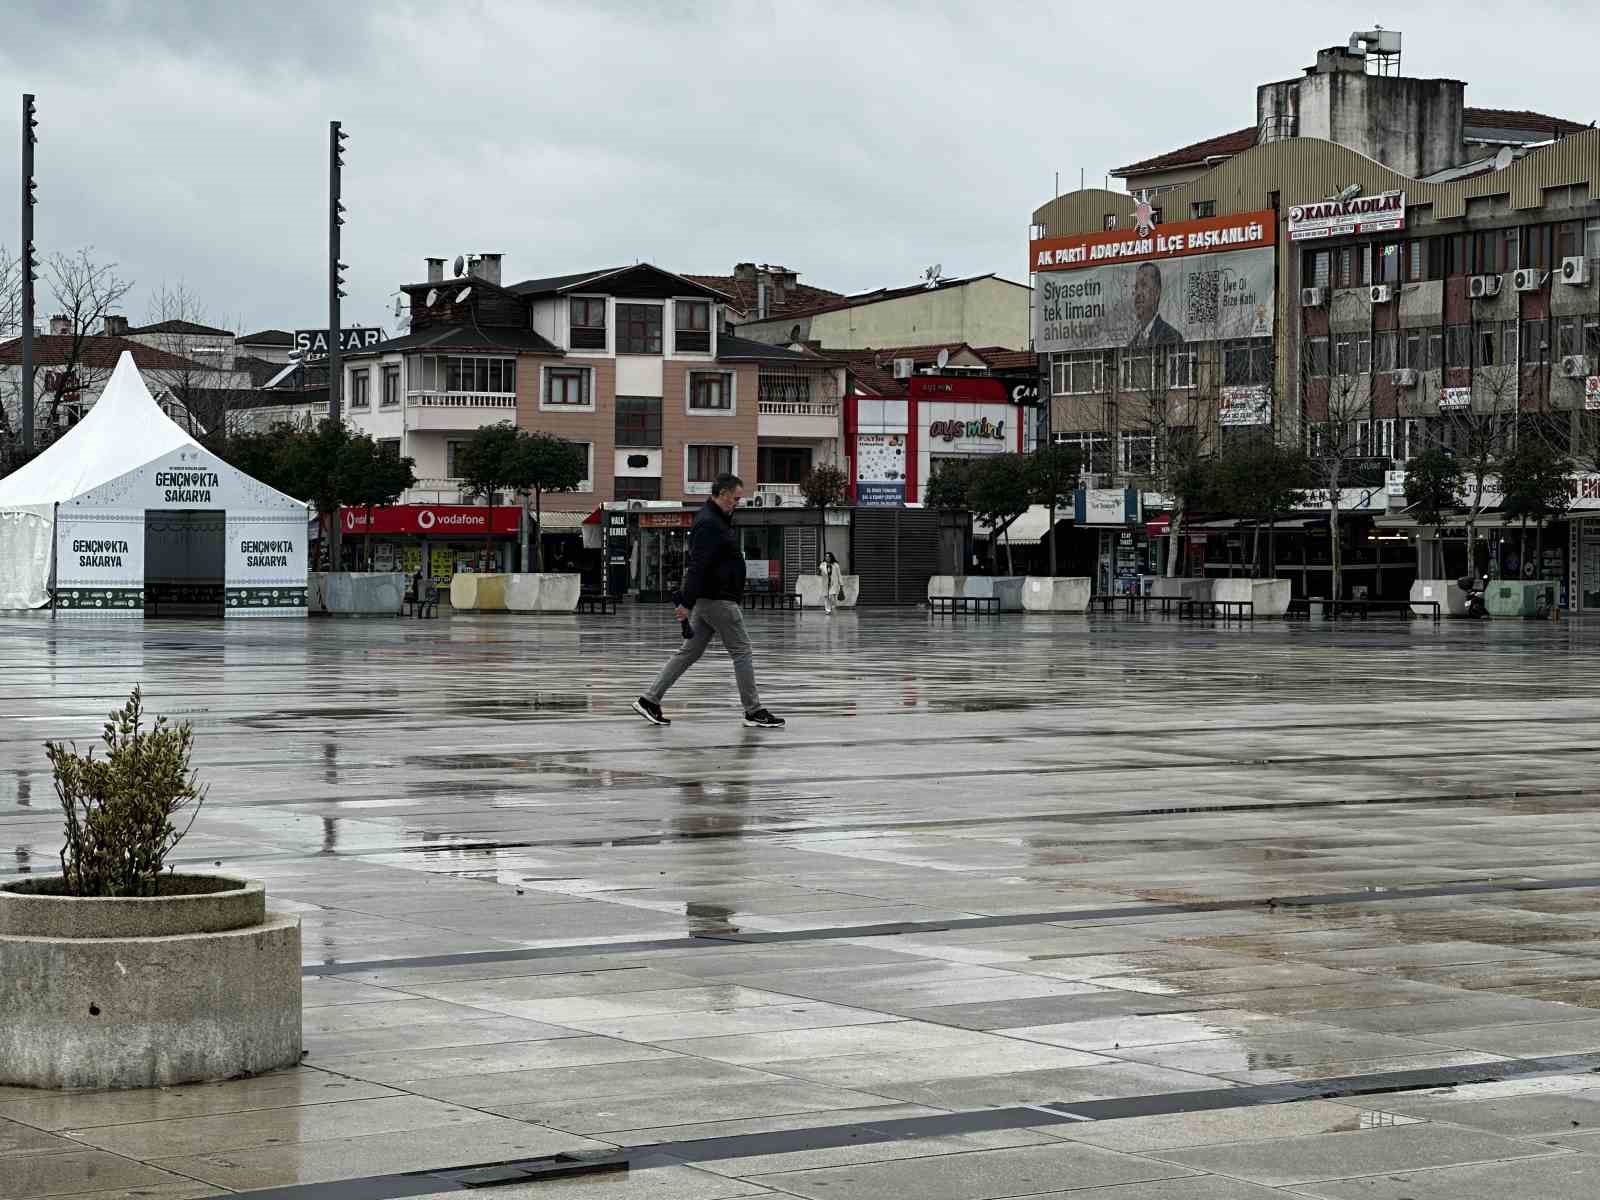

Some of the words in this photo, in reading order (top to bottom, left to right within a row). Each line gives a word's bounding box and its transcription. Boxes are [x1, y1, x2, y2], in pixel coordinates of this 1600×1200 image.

[1037, 251, 1053, 266] AK
[1055, 243, 1086, 264] PARTİ
[1089, 238, 1153, 260] ADAPAZARI
[1157, 233, 1184, 254] İLÇE
[1188, 222, 1262, 250] BAŞKANLIĞI
[1044, 280, 1101, 303] Siyasetin
[1044, 302, 1063, 321] tek
[1065, 302, 1104, 320] limanı
[930, 420, 965, 441] ays
[966, 417, 1004, 440] mini
[165, 490, 210, 502] SAKARYA
[437, 514, 486, 525] vodafone
[80, 556, 122, 567] SAKARYA
[247, 556, 287, 567] SAKARYA
